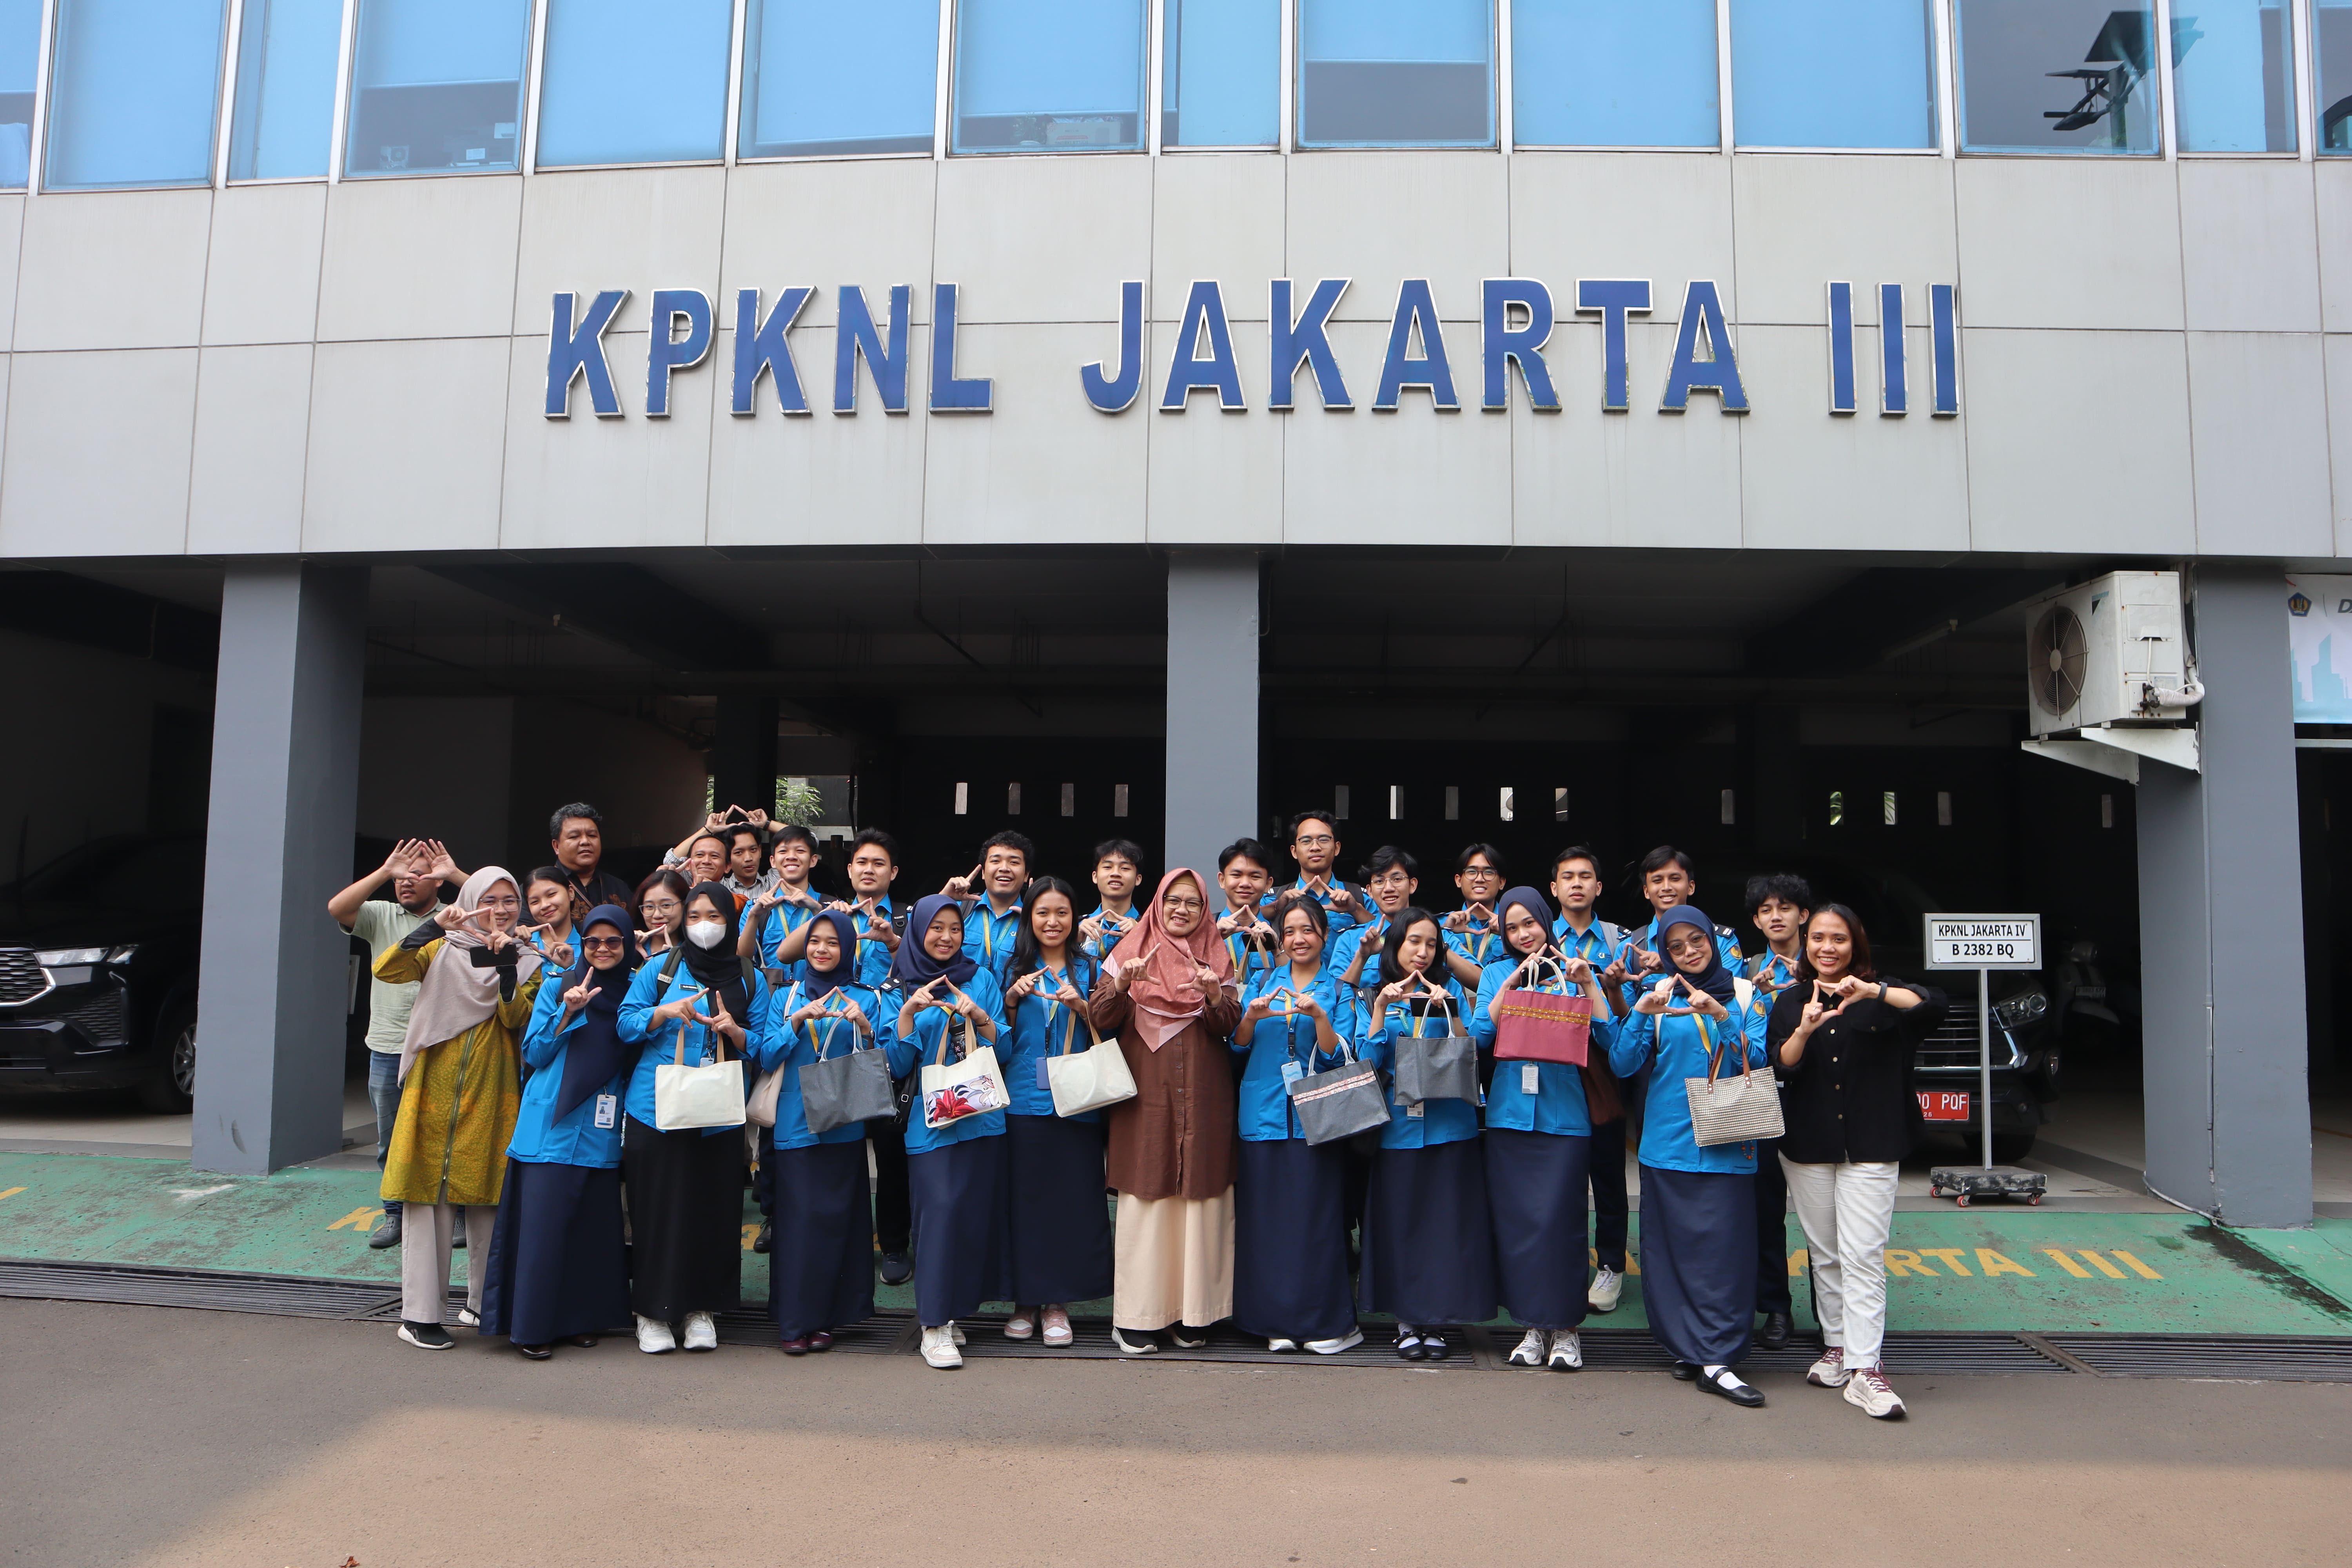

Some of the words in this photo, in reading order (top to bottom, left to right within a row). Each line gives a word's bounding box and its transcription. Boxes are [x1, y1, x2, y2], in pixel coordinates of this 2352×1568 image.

[543, 282, 994, 419] KPKNL
[1079, 278, 1750, 414] JAKARTA
[1824, 280, 1960, 416] III
[1938, 924, 1969, 936] KPKNL
[1971, 924, 2013, 936] JAKARTA
[2015, 924, 2026, 936] IV
[1952, 944, 1959, 955] B
[1964, 944, 1993, 955] 2382
[1997, 944, 2014, 958] BQ
[1942, 1093, 1967, 1111] PQF
[2042, 1249, 2164, 1279] III
